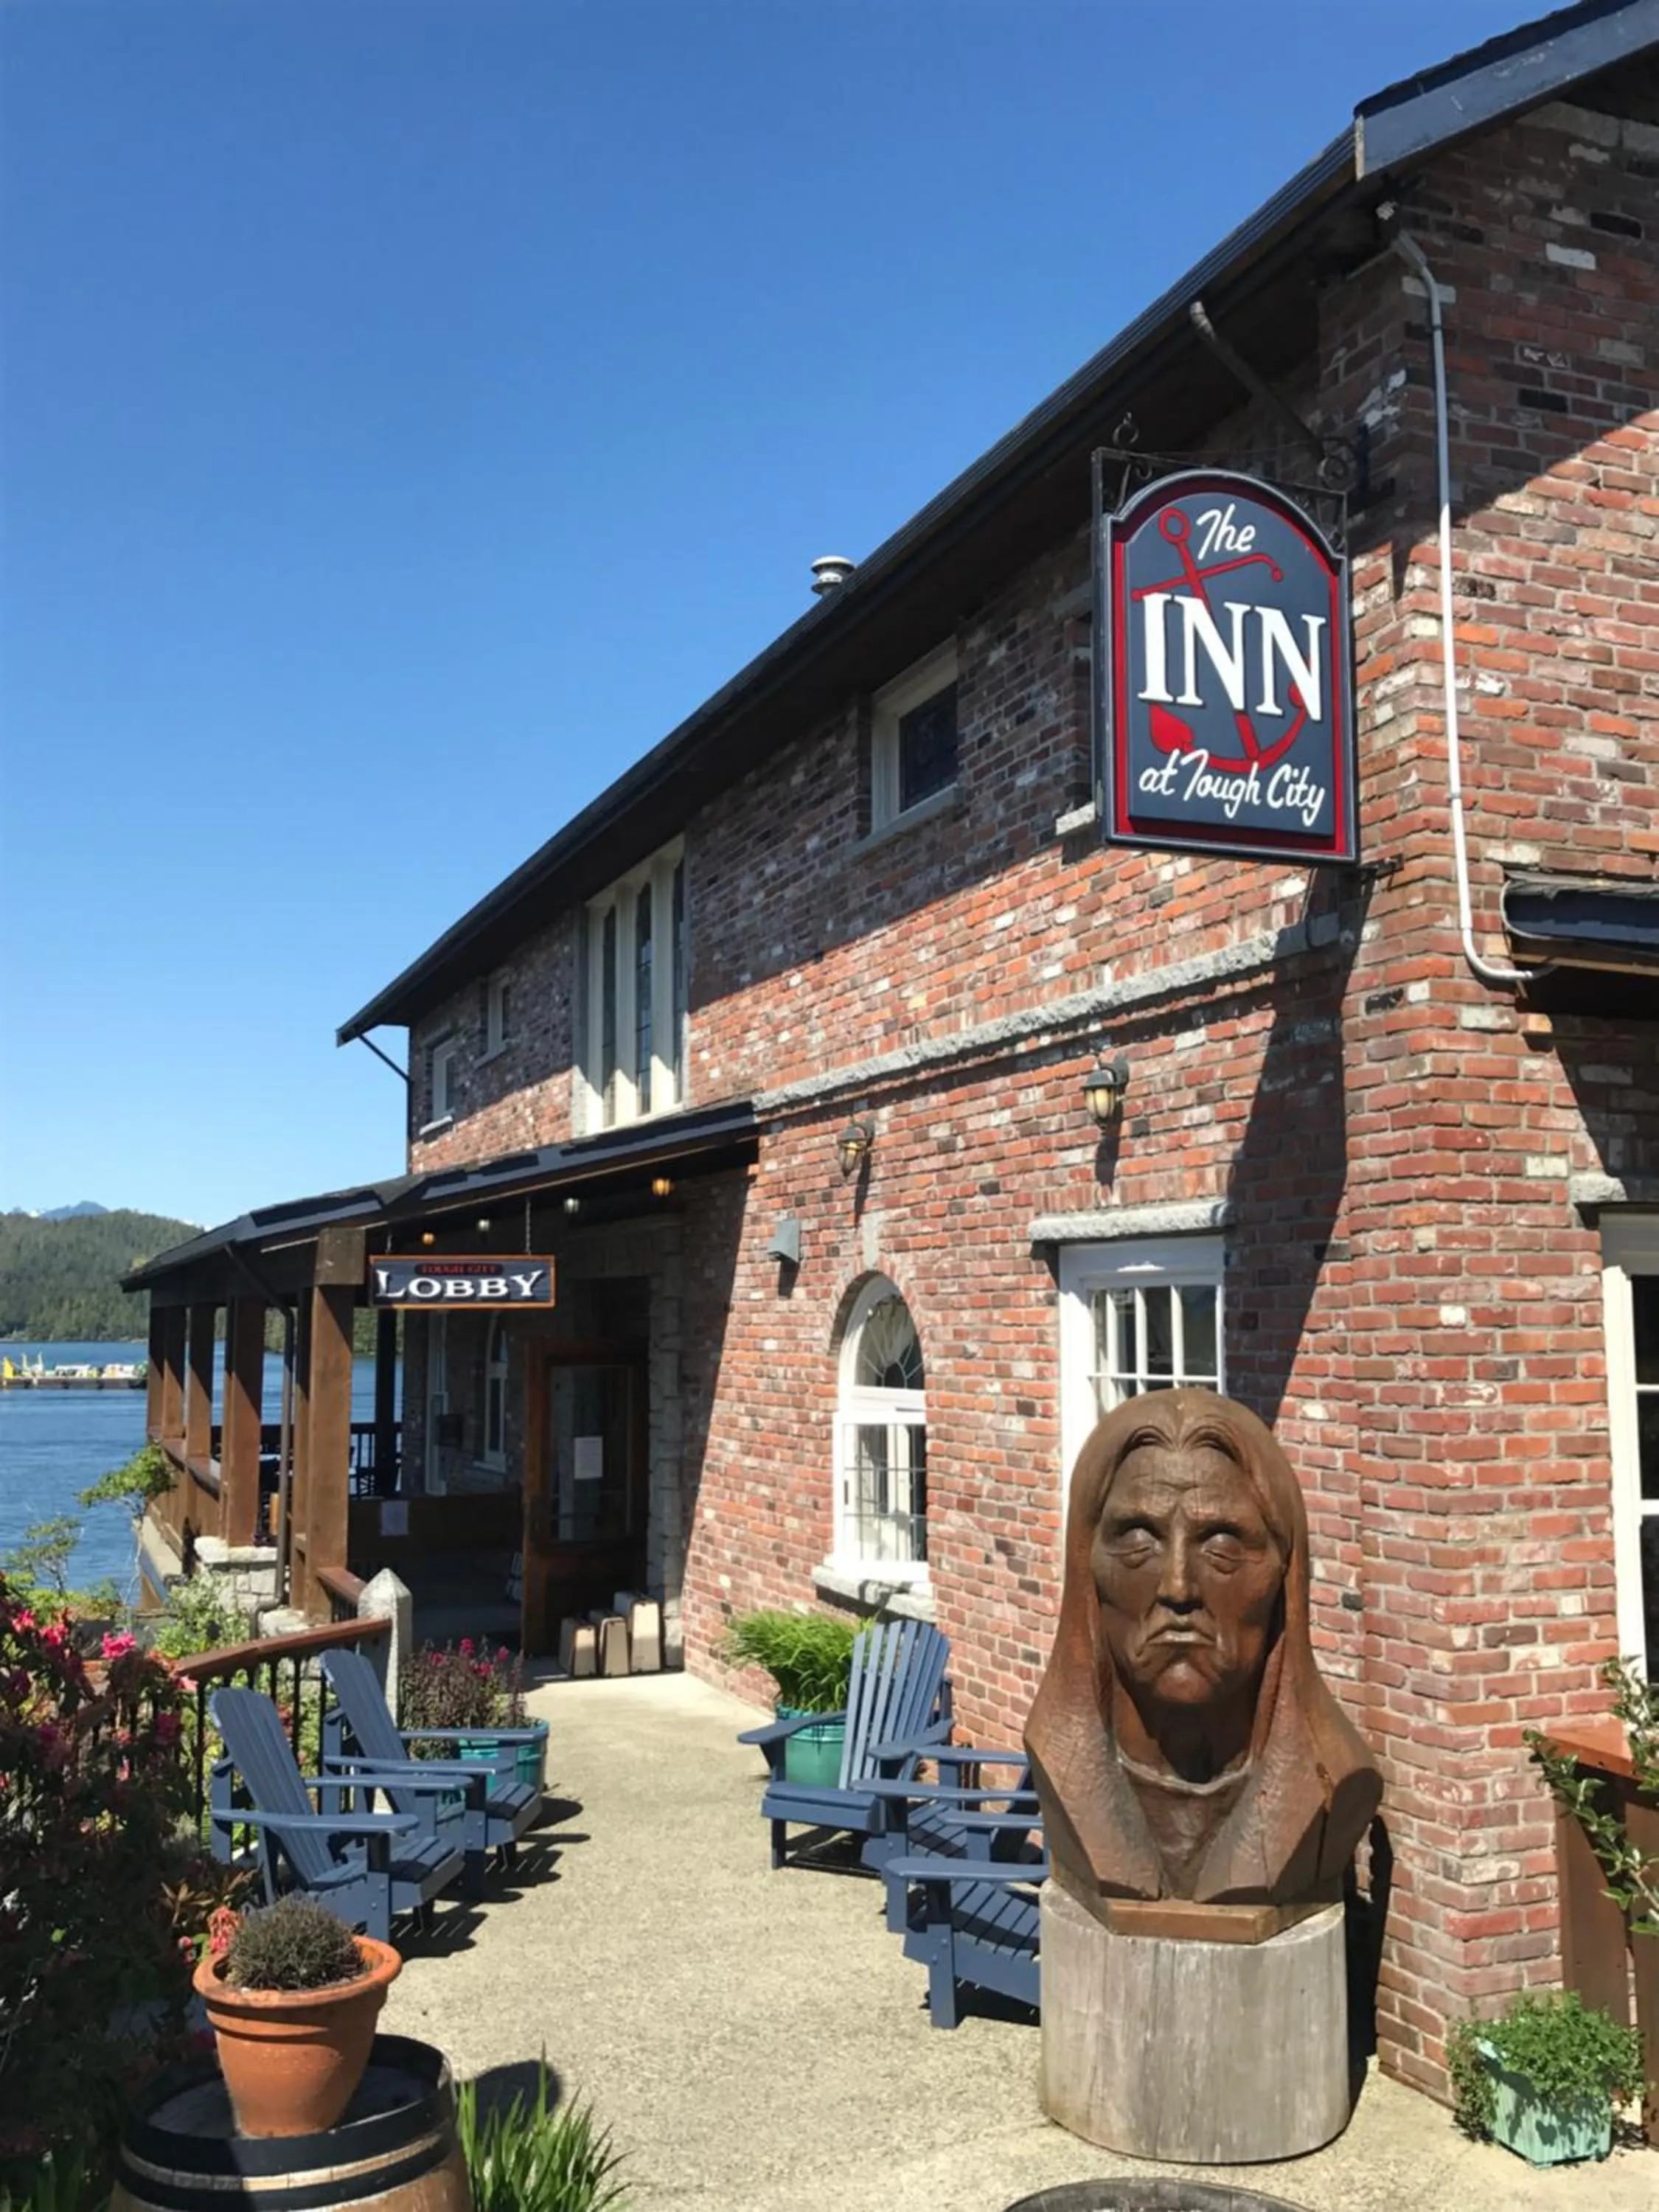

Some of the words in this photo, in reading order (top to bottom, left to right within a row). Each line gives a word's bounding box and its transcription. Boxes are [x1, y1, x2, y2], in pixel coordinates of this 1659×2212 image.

[1196, 504, 1256, 560] The
[1138, 593, 1326, 720] INN
[1138, 748, 1180, 795] at
[1180, 748, 1262, 818] Tough
[1267, 764, 1325, 827] City
[376, 1269, 543, 1298] LOBBY
